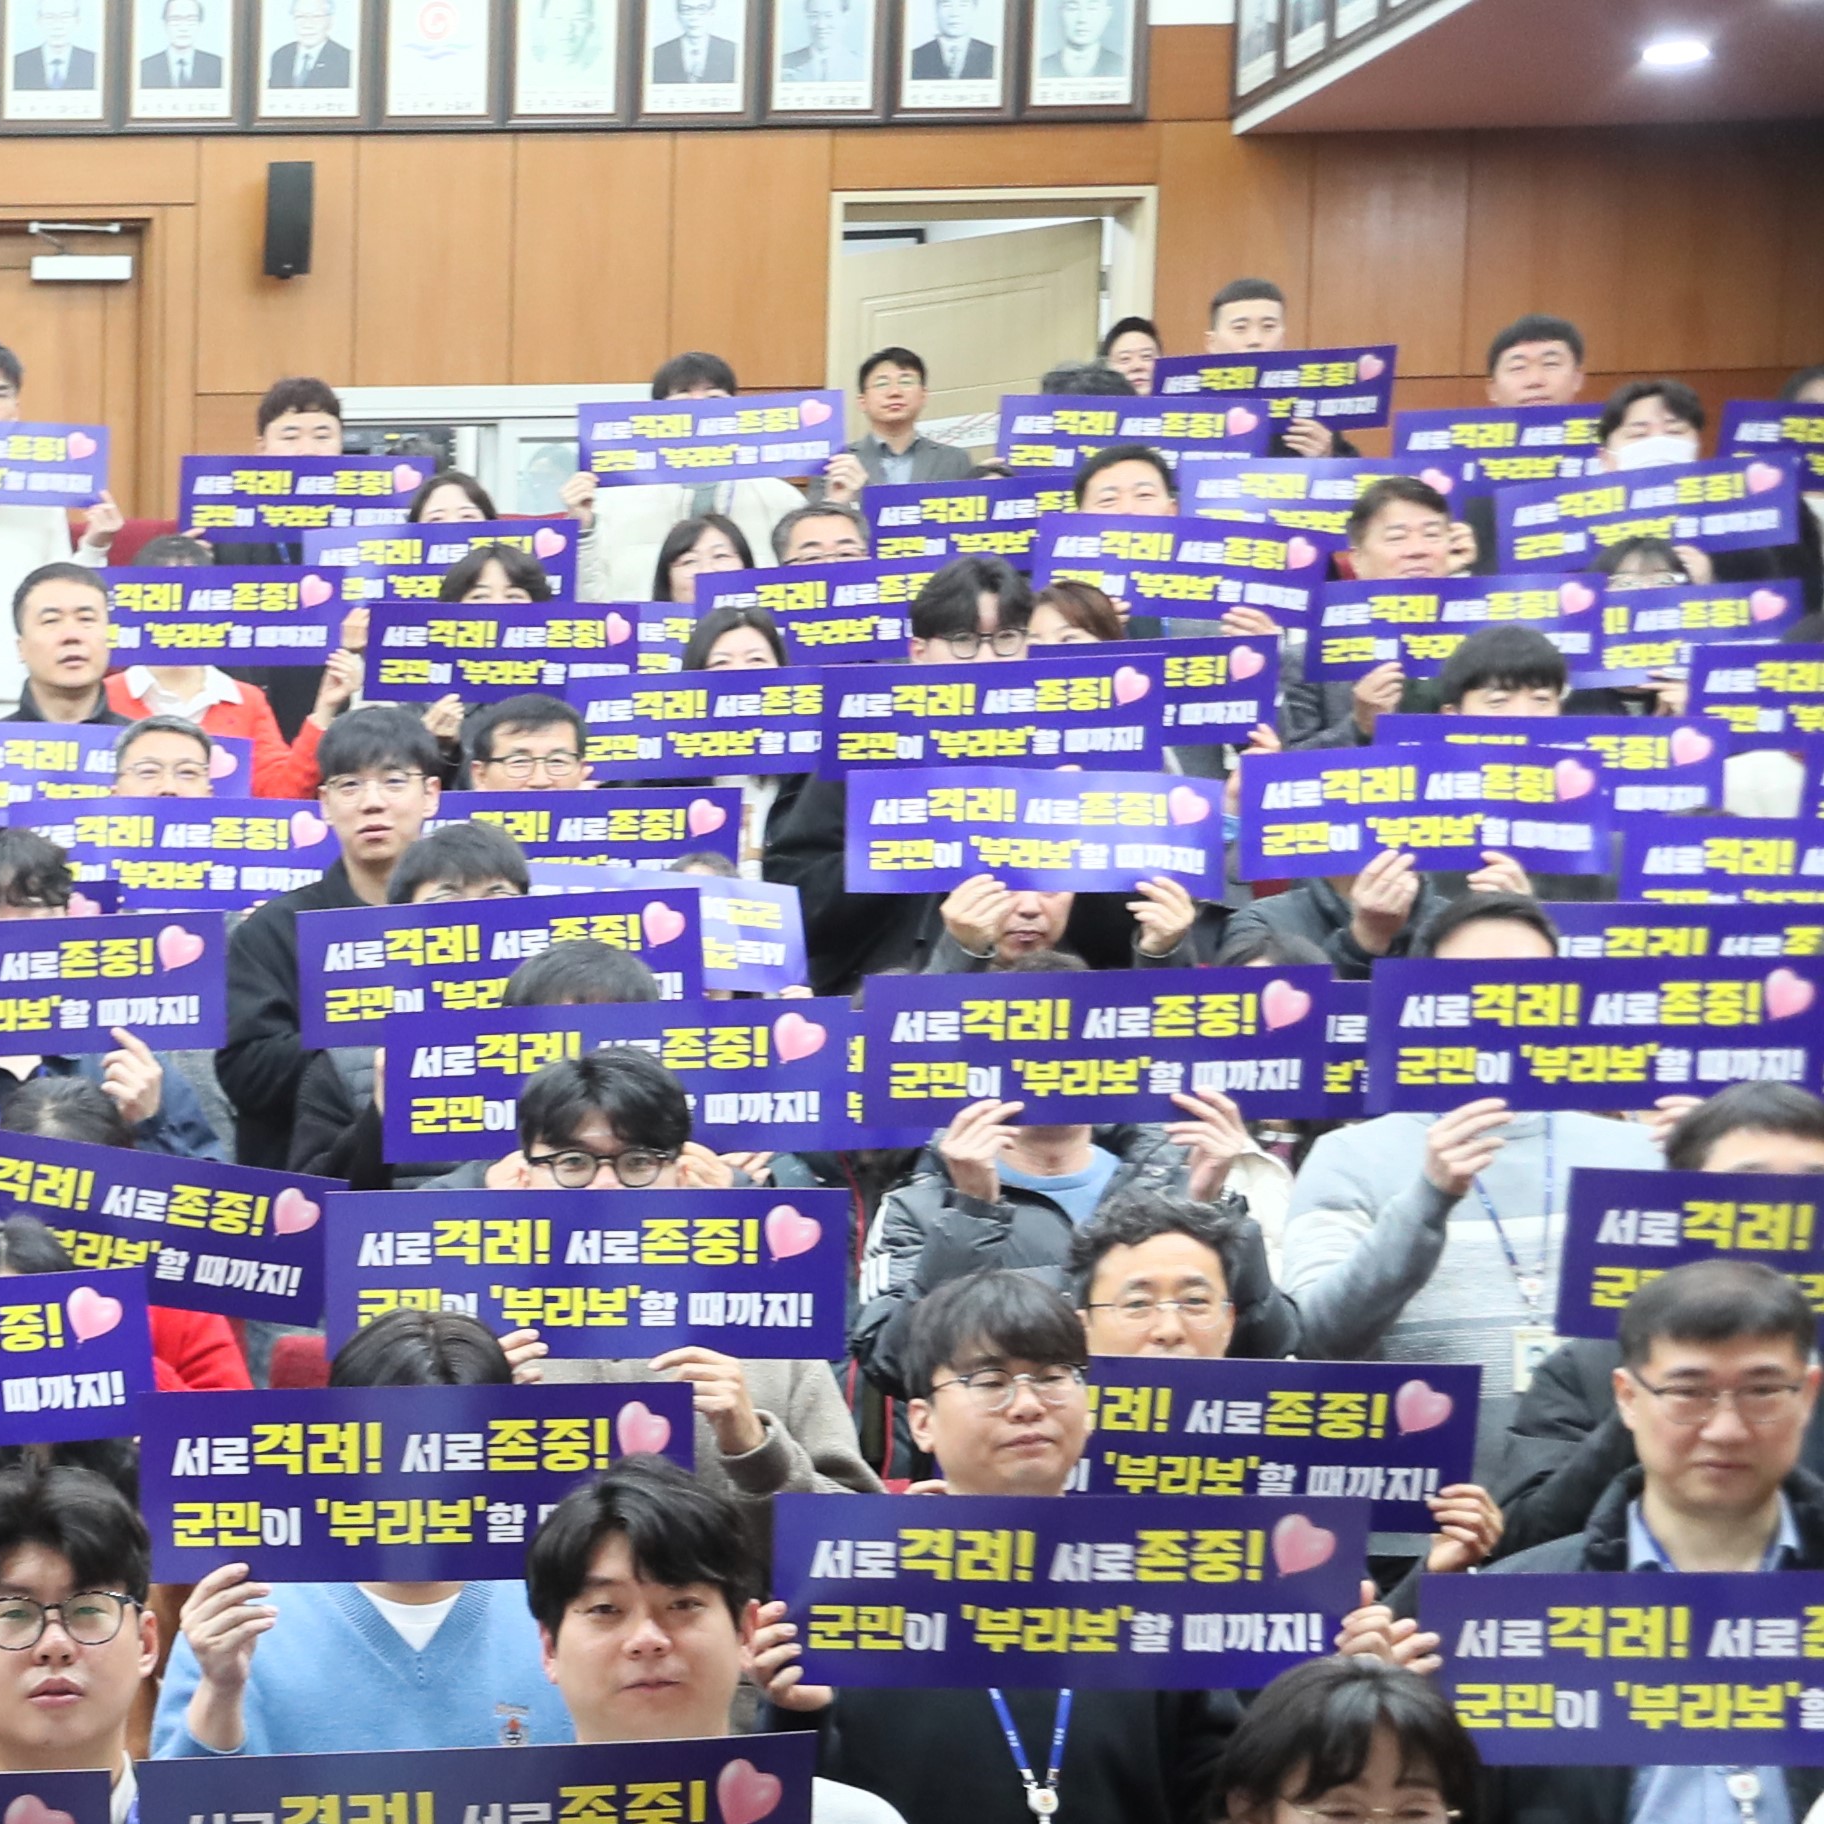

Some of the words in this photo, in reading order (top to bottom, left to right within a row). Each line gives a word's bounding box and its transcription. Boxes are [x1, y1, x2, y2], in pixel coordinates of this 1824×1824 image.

[592, 412, 691, 442] 서로격려!
[698, 406, 798, 436] 서로존중!
[297, 470, 392, 496] 서로존중!
[381, 618, 497, 648] 서로격려!
[839, 681, 974, 719] 서로격려!
[983, 678, 1110, 714] 서로존중!
[839, 731, 923, 763] 군민이
[932, 724, 1058, 758] '부라보'할
[1064, 725, 1145, 752] 때까지!
[870, 788, 1016, 824] 서로격려!
[1026, 791, 1165, 826] 서로존중!
[1262, 767, 1413, 806] 서로격려!
[162, 818, 287, 850] 서로존중!
[870, 837, 961, 869] 군민이
[1262, 820, 1360, 856] 군민이
[0, 937, 152, 982] 서로존중!
[98, 994, 198, 1027] 때까지!
[890, 997, 1070, 1043] 서로격려!
[1083, 994, 1256, 1039] 서로존중!
[1400, 982, 1579, 1027] 서로격려!
[1591, 982, 1760, 1026] 서로존중!
[889, 1061, 1001, 1101] 군민이
[1013, 1054, 1182, 1097] '부라보'할
[1191, 1058, 1302, 1091] 때까지!
[1398, 1046, 1510, 1086] 군민이
[1522, 1042, 1688, 1084] '부라보'할
[1697, 1047, 1804, 1080] 때까지!
[100, 1183, 271, 1237] 서로존중!
[1595, 1201, 1816, 1250] 서로격려!
[357, 1218, 550, 1266] 서로격려!
[565, 1218, 757, 1266] 서로존중!
[193, 1254, 303, 1297] 때까지!
[490, 1284, 677, 1328] '부라보'할
[688, 1290, 812, 1326] 때까지!
[2, 1371, 127, 1413] 때까지!
[1184, 1390, 1390, 1439] 서로존중!
[171, 1421, 383, 1477] 서로격려!
[401, 1418, 609, 1473] 서로존중!
[1103, 1452, 1297, 1496] '부라보'할
[1305, 1465, 1440, 1501] 때까지!
[171, 1499, 301, 1549] 군민이
[316, 1494, 526, 1546] '부라보'할
[810, 1526, 1033, 1582] 서로격려!
[1049, 1529, 1264, 1584] 서로존중!
[808, 1604, 947, 1652] 군민이
[962, 1602, 1172, 1653] '부라보'할
[1183, 1612, 1321, 1653] 때까지!
[1455, 1605, 1691, 1660] 서로격려!
[1454, 1682, 1600, 1730] 군민이
[1613, 1681, 1824, 1731] '부라보'할
